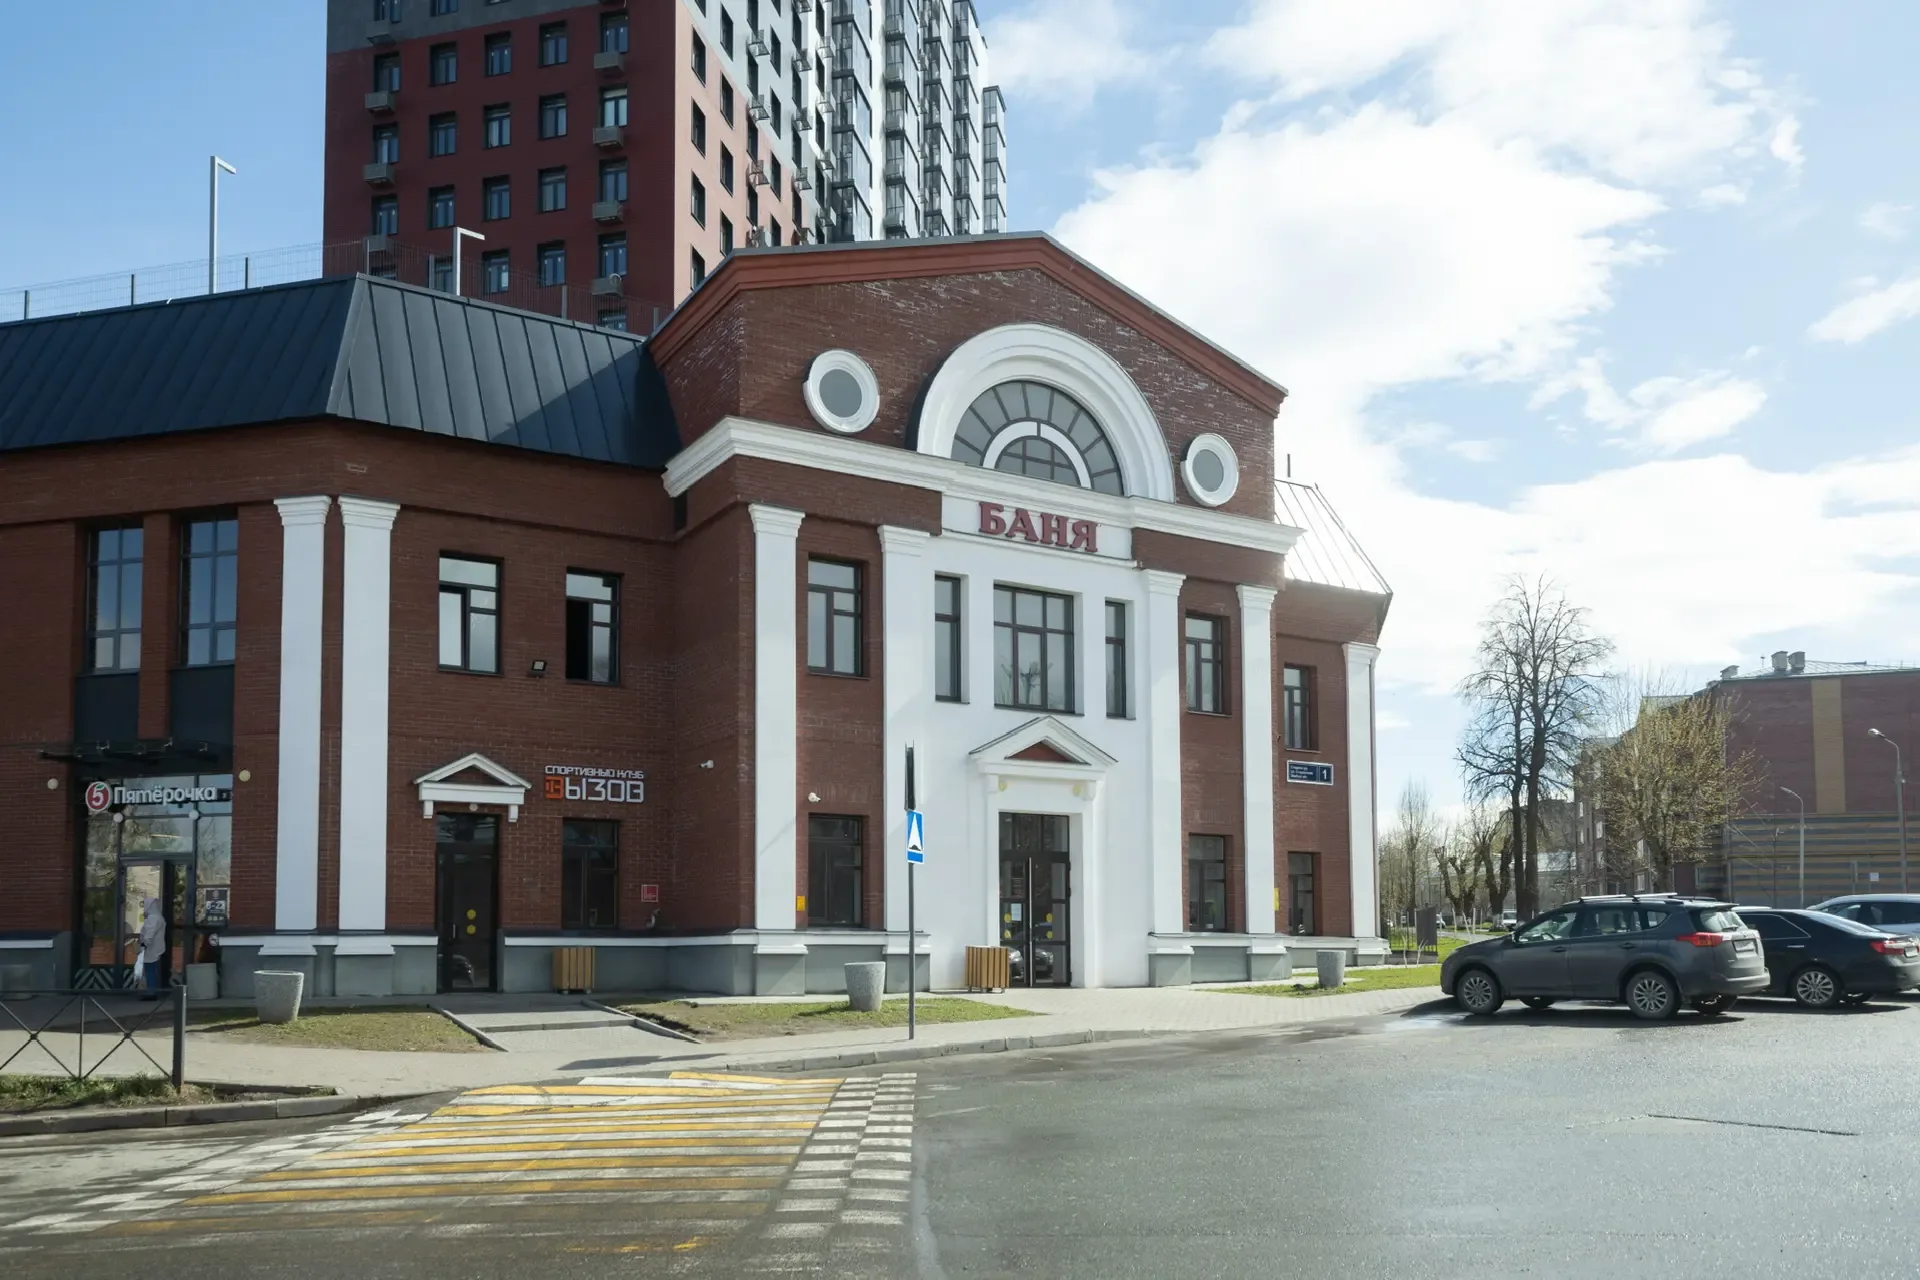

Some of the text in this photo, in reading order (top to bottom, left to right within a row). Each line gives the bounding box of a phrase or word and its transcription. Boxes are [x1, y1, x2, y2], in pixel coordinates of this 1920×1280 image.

[979, 501, 1098, 553] БАНЯ
[616, 769, 644, 780] КЛУБ
[1322, 769, 1328, 780] 1
[113, 786, 217, 806] Пятёрочка
[544, 776, 644, 803] ВЫЗОВ
